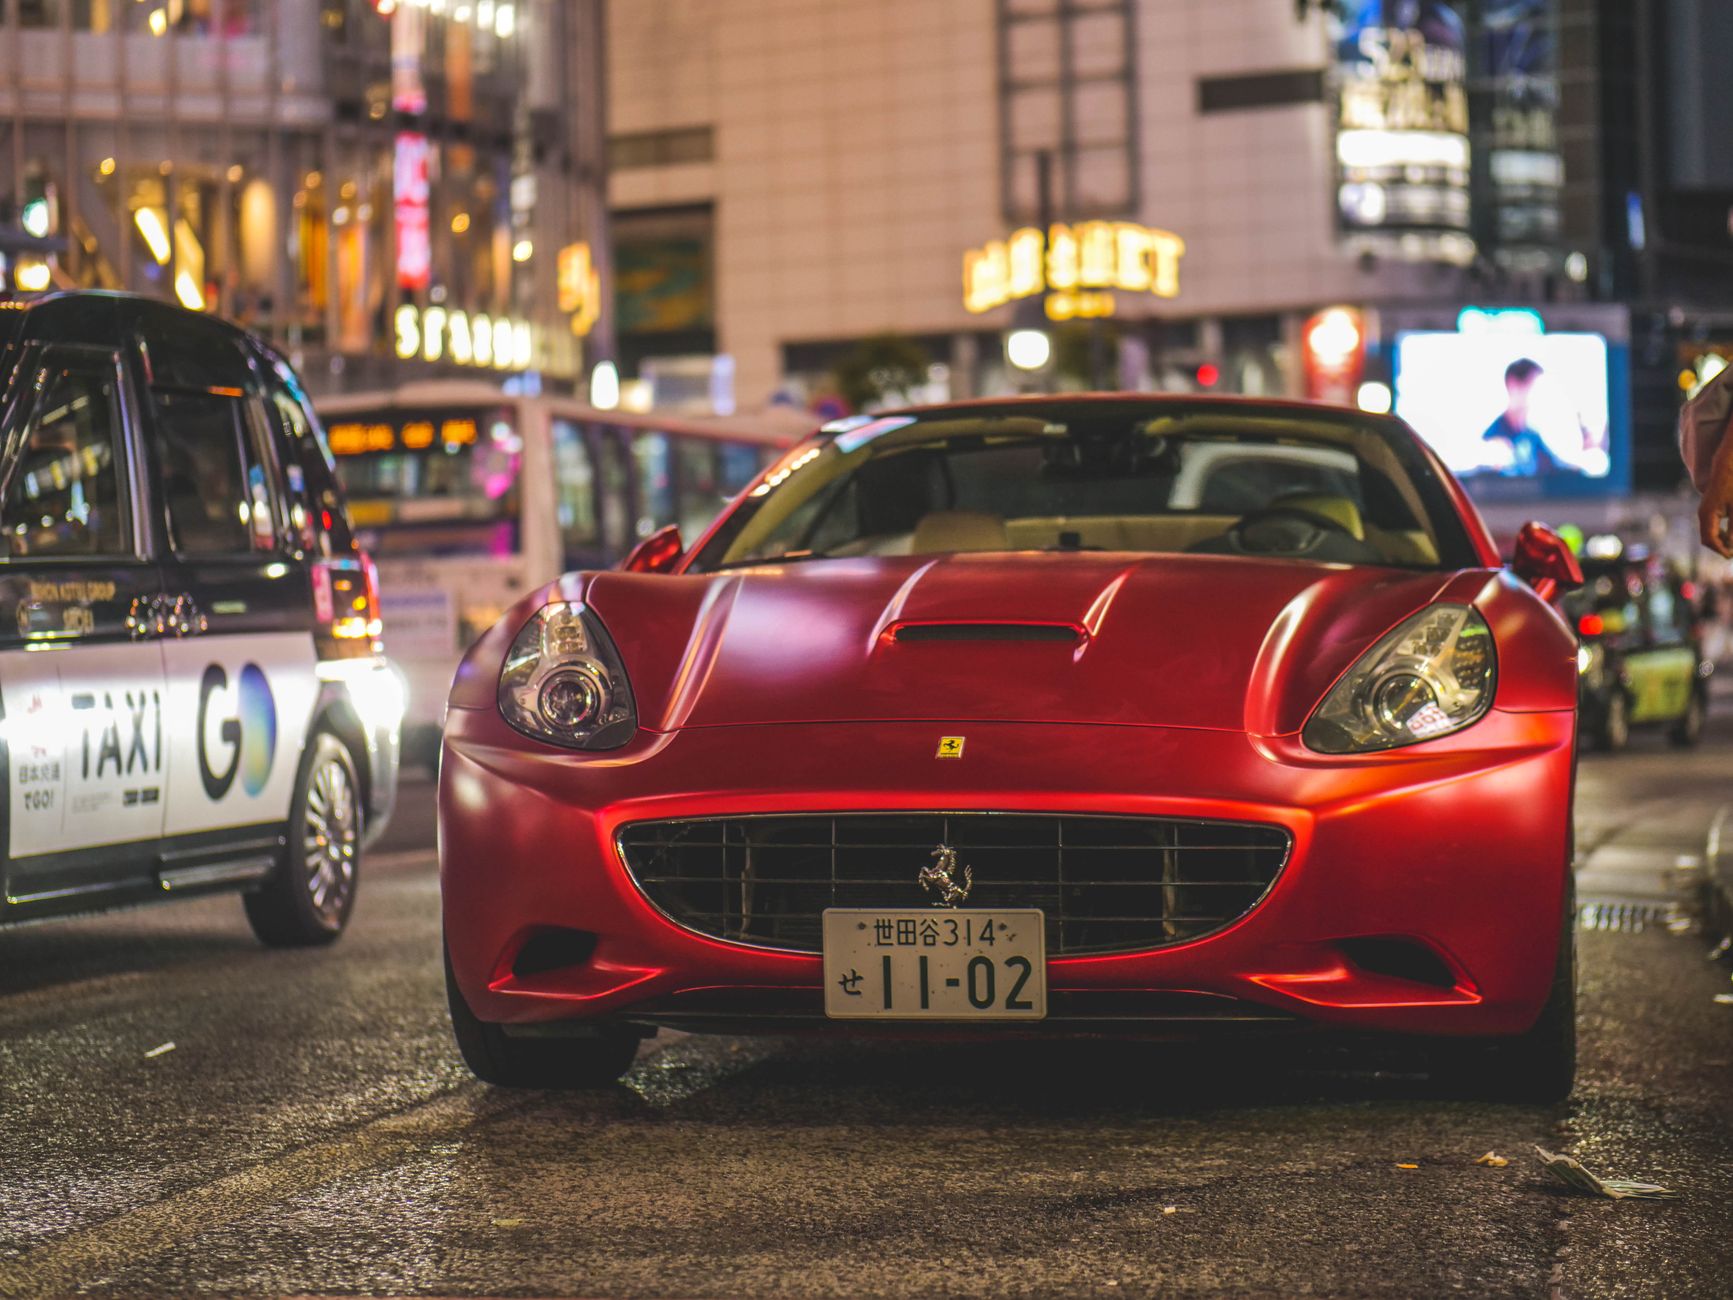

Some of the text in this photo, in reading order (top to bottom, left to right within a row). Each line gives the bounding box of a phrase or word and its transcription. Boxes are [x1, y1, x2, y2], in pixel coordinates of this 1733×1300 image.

[71, 690, 160, 780] TAXI
[838, 955, 1033, 1010] せ 11-02
